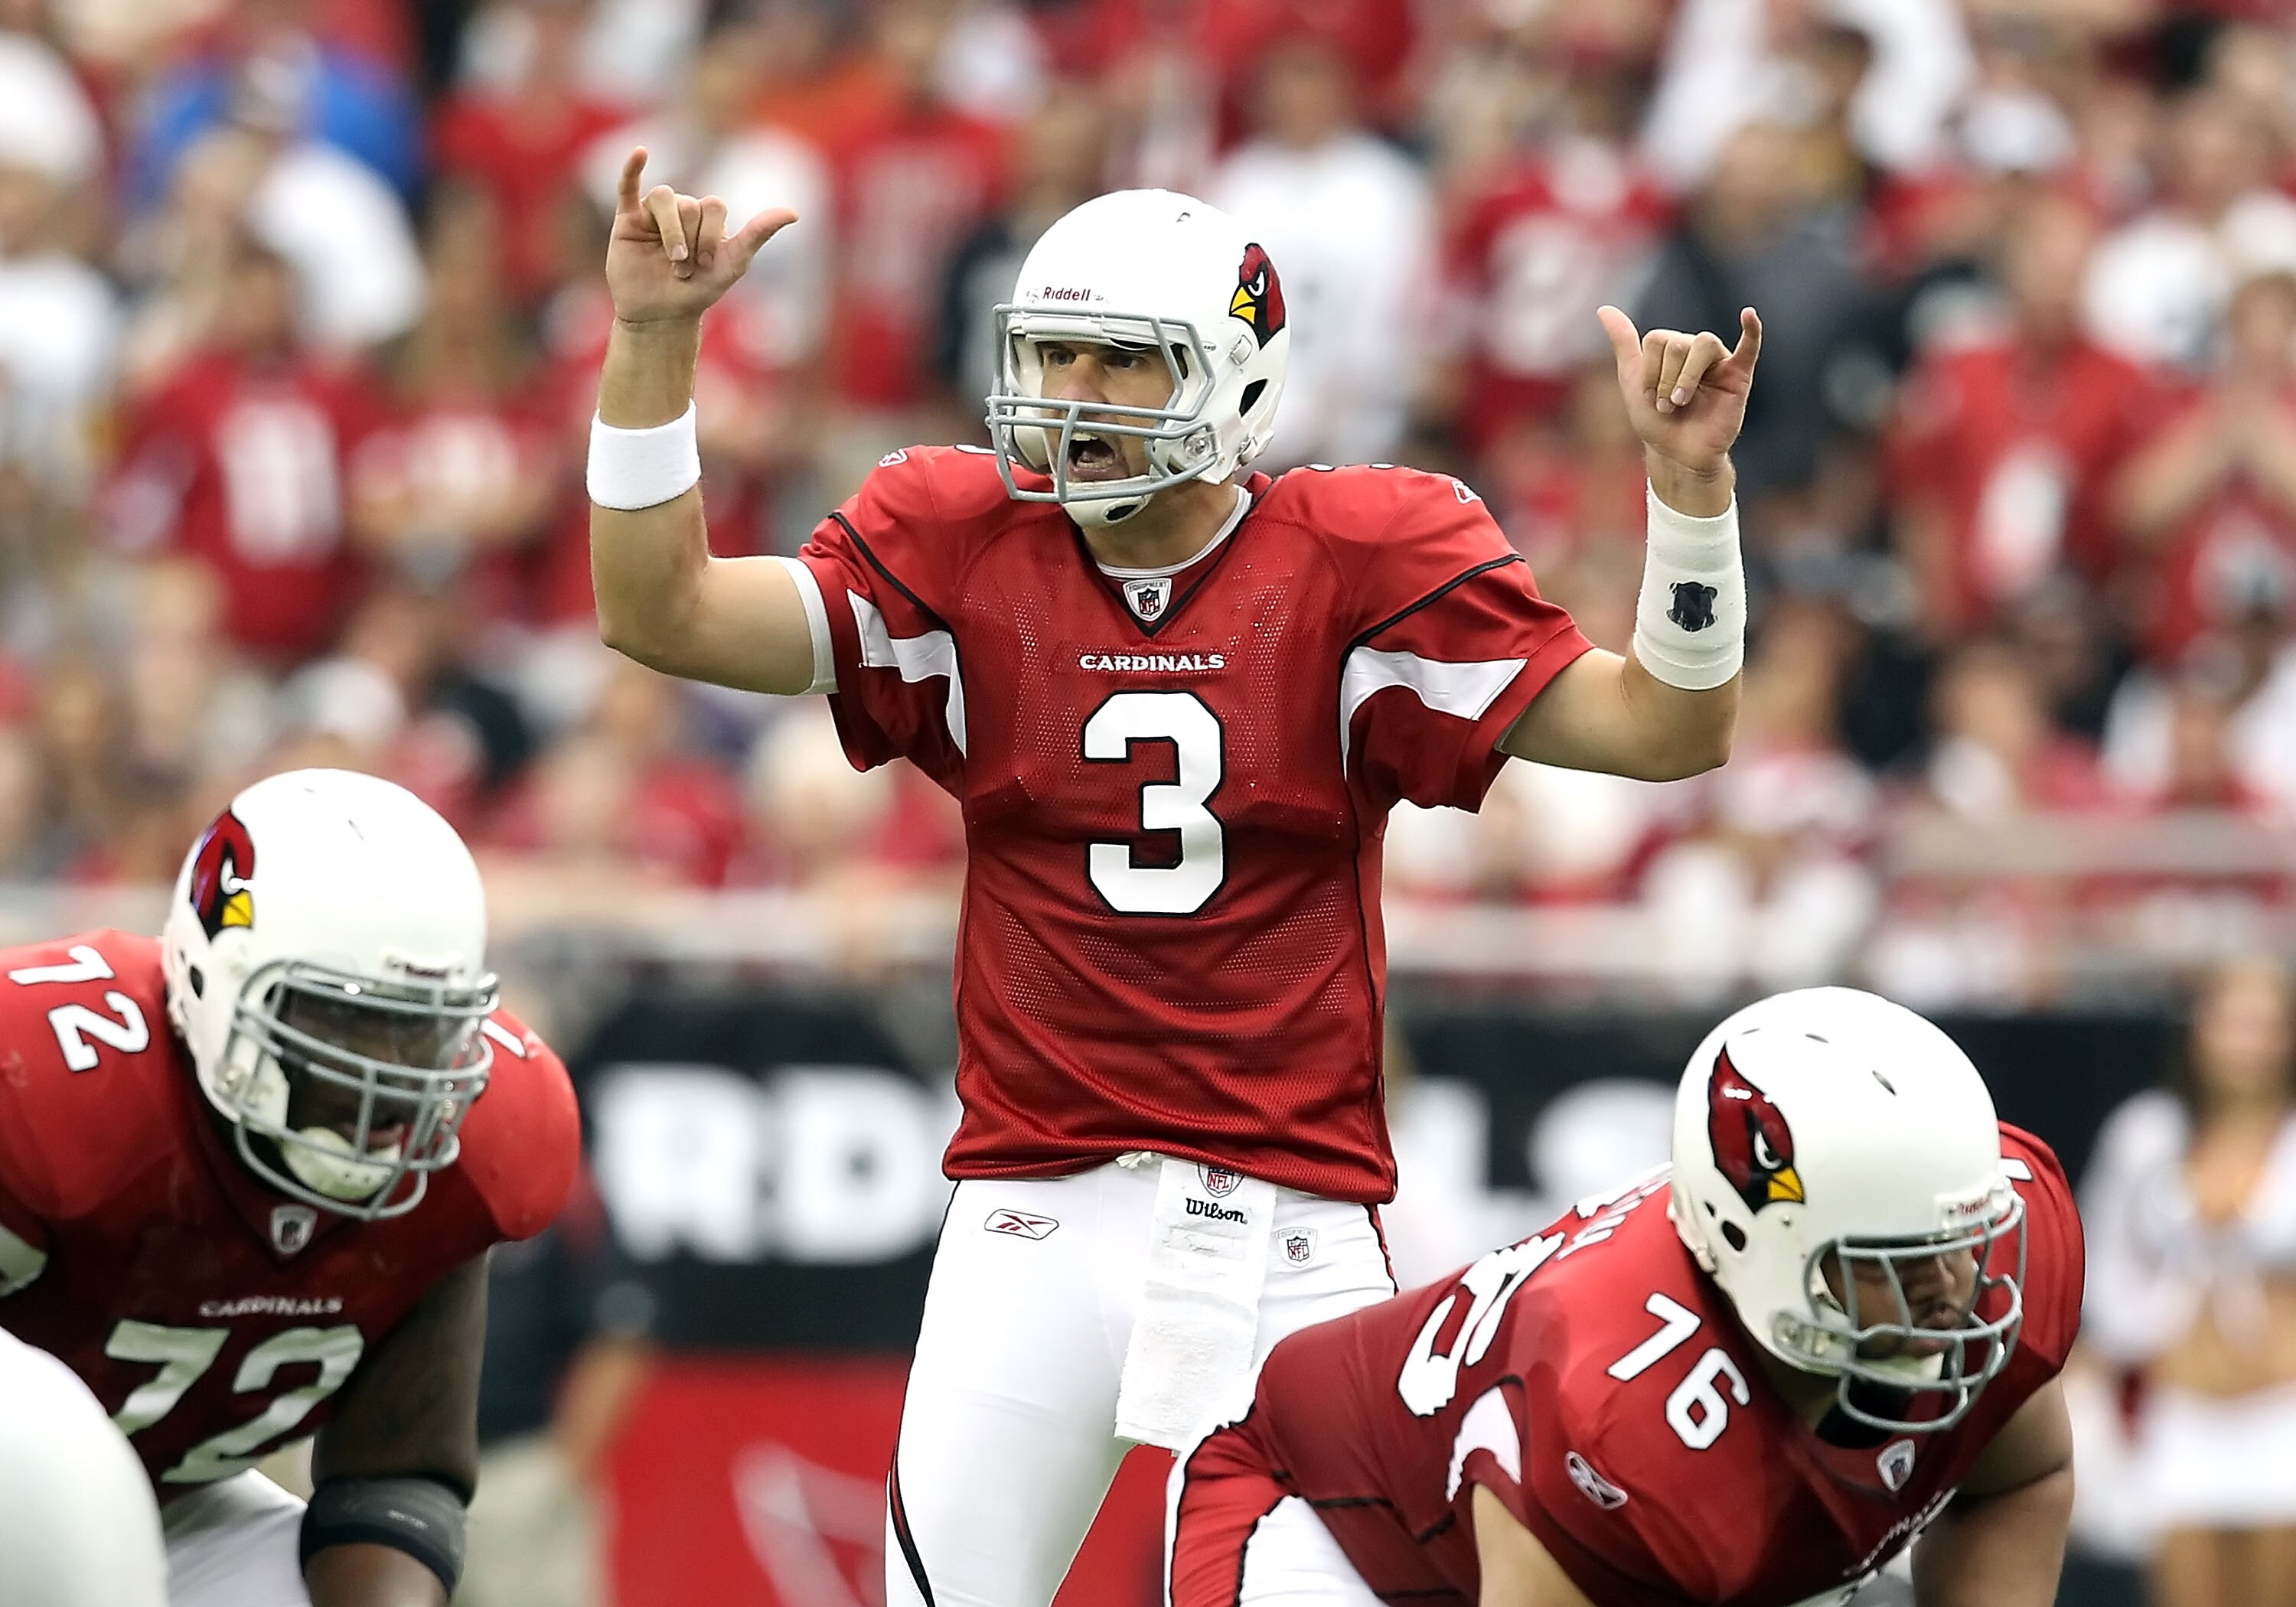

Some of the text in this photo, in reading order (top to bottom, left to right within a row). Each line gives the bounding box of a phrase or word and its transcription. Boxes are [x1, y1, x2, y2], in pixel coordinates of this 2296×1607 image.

[1042, 286, 1091, 302] Riddell
[1079, 654, 1225, 672] CARDINALS
[1081, 690, 1226, 916] 3
[7, 944, 150, 1072] 72
[1208, 1172, 1229, 1190] NFL
[1186, 1198, 1245, 1224] Wilson
[1289, 1246, 1309, 1261] NFL
[1606, 1291, 1751, 1451] 76
[105, 1318, 365, 1483] 72
